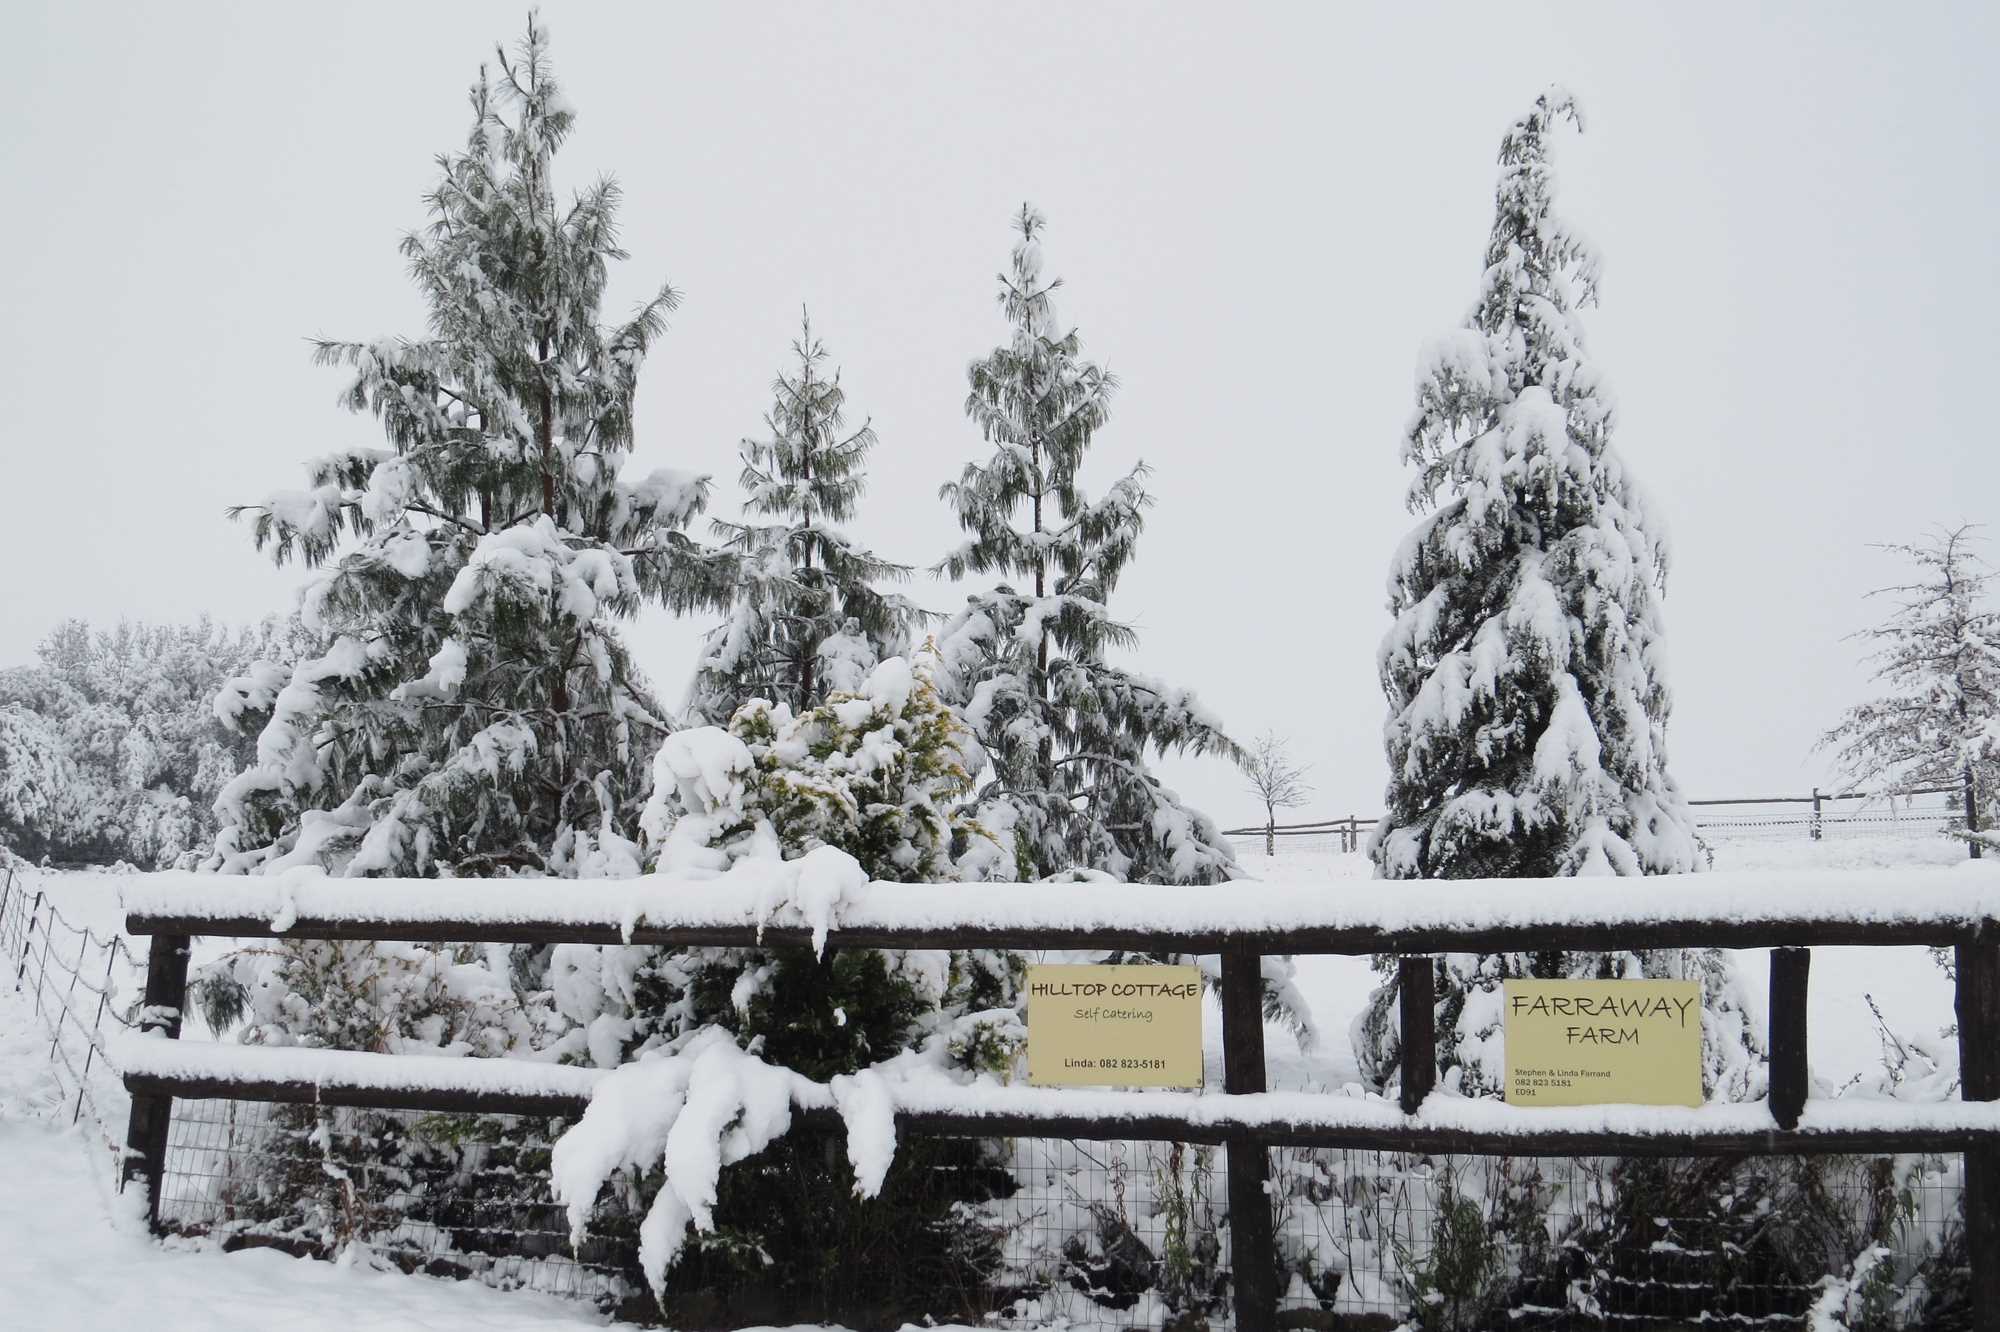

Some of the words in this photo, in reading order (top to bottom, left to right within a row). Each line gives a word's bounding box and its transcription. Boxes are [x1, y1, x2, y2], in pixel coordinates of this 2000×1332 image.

[1031, 983, 1107, 997] HILLTOP
[1111, 983, 1198, 1000] COTTAGE
[1073, 1007, 1101, 1023] Self
[1102, 1008, 1153, 1023] Catering
[1512, 995, 1694, 1028] FARRAWAY
[1566, 1026, 1640, 1045] FARM
[1064, 1058, 1096, 1068] Linda:
[1099, 1059, 1118, 1069] 082
[1121, 1059, 1166, 1069] 823-5181
[1515, 1069, 1547, 1078] Stephen
[1549, 1069, 1555, 1077] &
[1557, 1069, 1579, 1077] Linda
[1515, 1078, 1531, 1086] 082
[1532, 1079, 1549, 1087] 823
[1551, 1079, 1571, 1087] 5181
